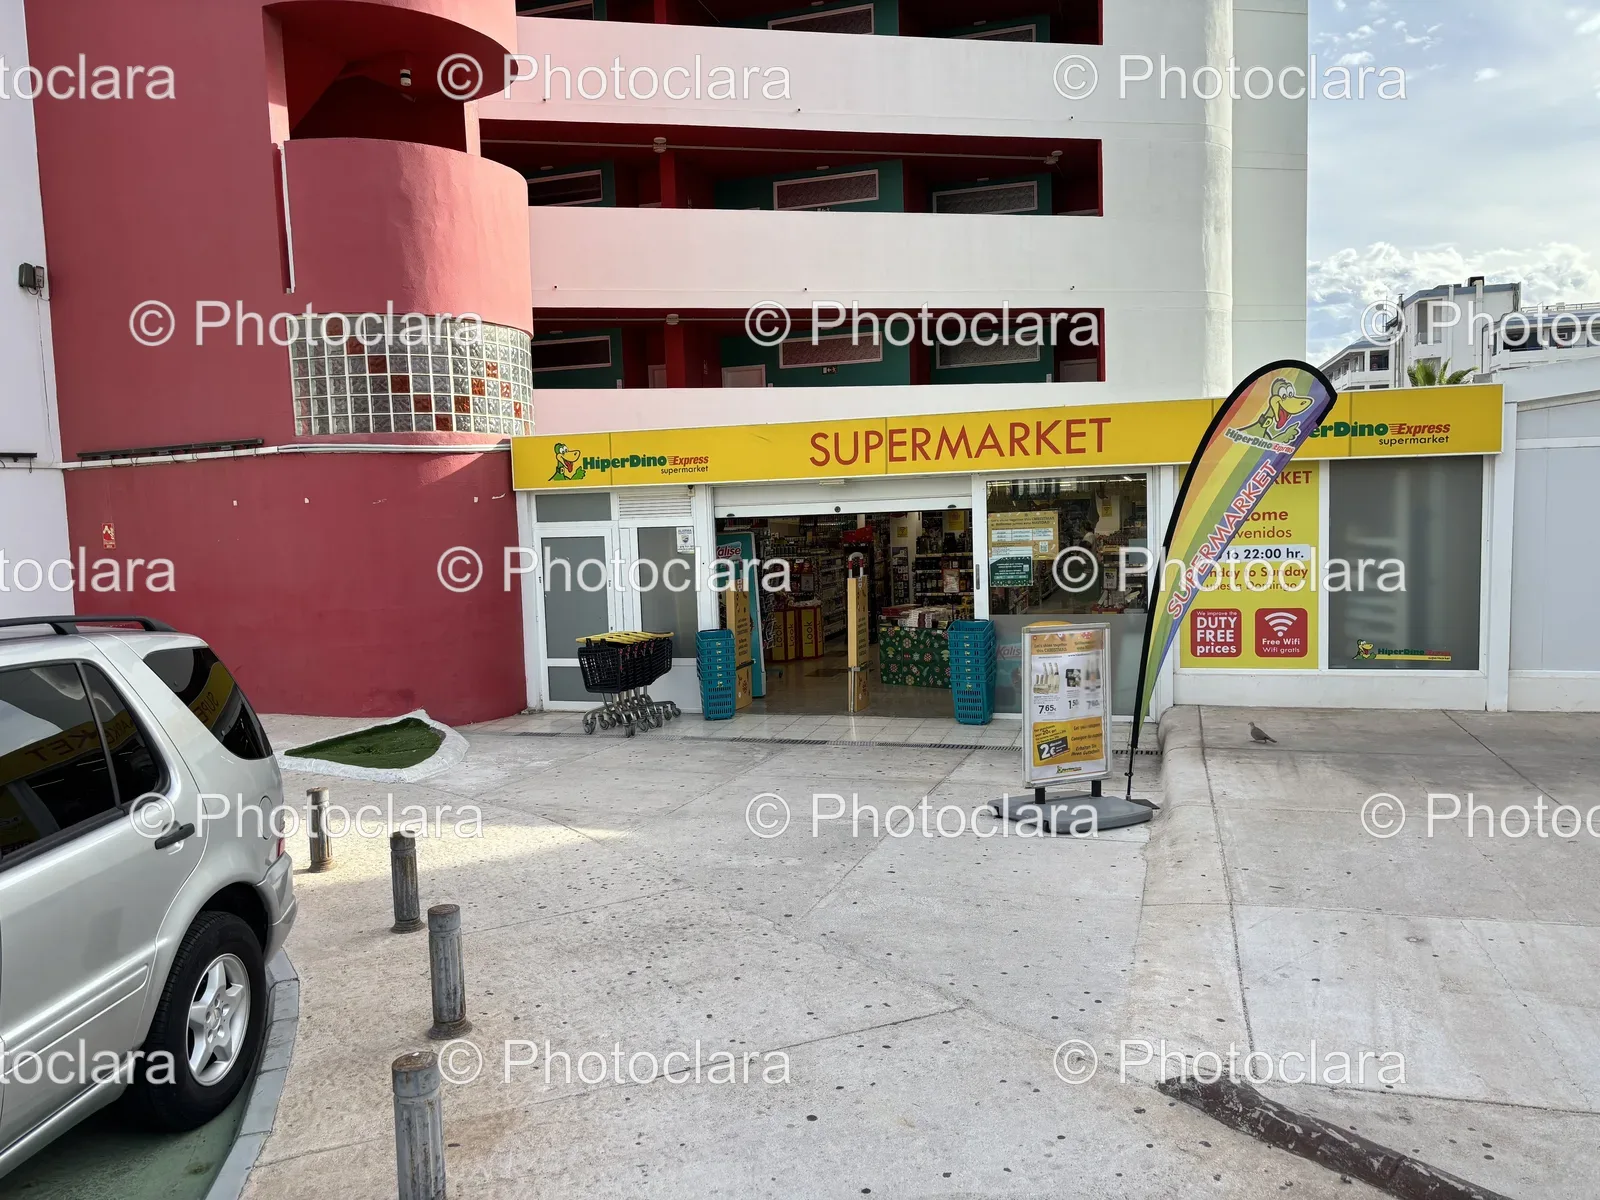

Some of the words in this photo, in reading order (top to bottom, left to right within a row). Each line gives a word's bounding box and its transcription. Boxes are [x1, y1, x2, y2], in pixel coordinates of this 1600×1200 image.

[1309, 421, 1389, 438] erDino
[1397, 423, 1451, 437] Express
[810, 417, 1112, 467] SUPERMARKET
[1225, 429, 1273, 449] HiperDino
[1379, 435, 1450, 447] supermarket
[582, 454, 668, 472] HiperDino
[673, 455, 709, 467] Express
[661, 465, 709, 475] supermarket
[1274, 470, 1313, 485] KET
[1246, 510, 1289, 522] ome
[1167, 459, 1277, 619] SUPERMARKET
[1237, 525, 1293, 539] venidos
[717, 546, 741, 558] alise
[1244, 548, 1282, 560] 22:00
[1286, 547, 1304, 559] hr.
[1210, 566, 1241, 580] nday
[1260, 566, 1308, 579] Sunday
[1197, 616, 1238, 629] DUTY
[805, 621, 813, 645] Look
[1196, 629, 1235, 642] FREE
[1262, 638, 1281, 646] Free
[1283, 637, 1301, 646] Wifi
[996, 644, 1022, 660] Kalis
[1196, 642, 1237, 656] prices
[1377, 648, 1425, 656] HiperDino
